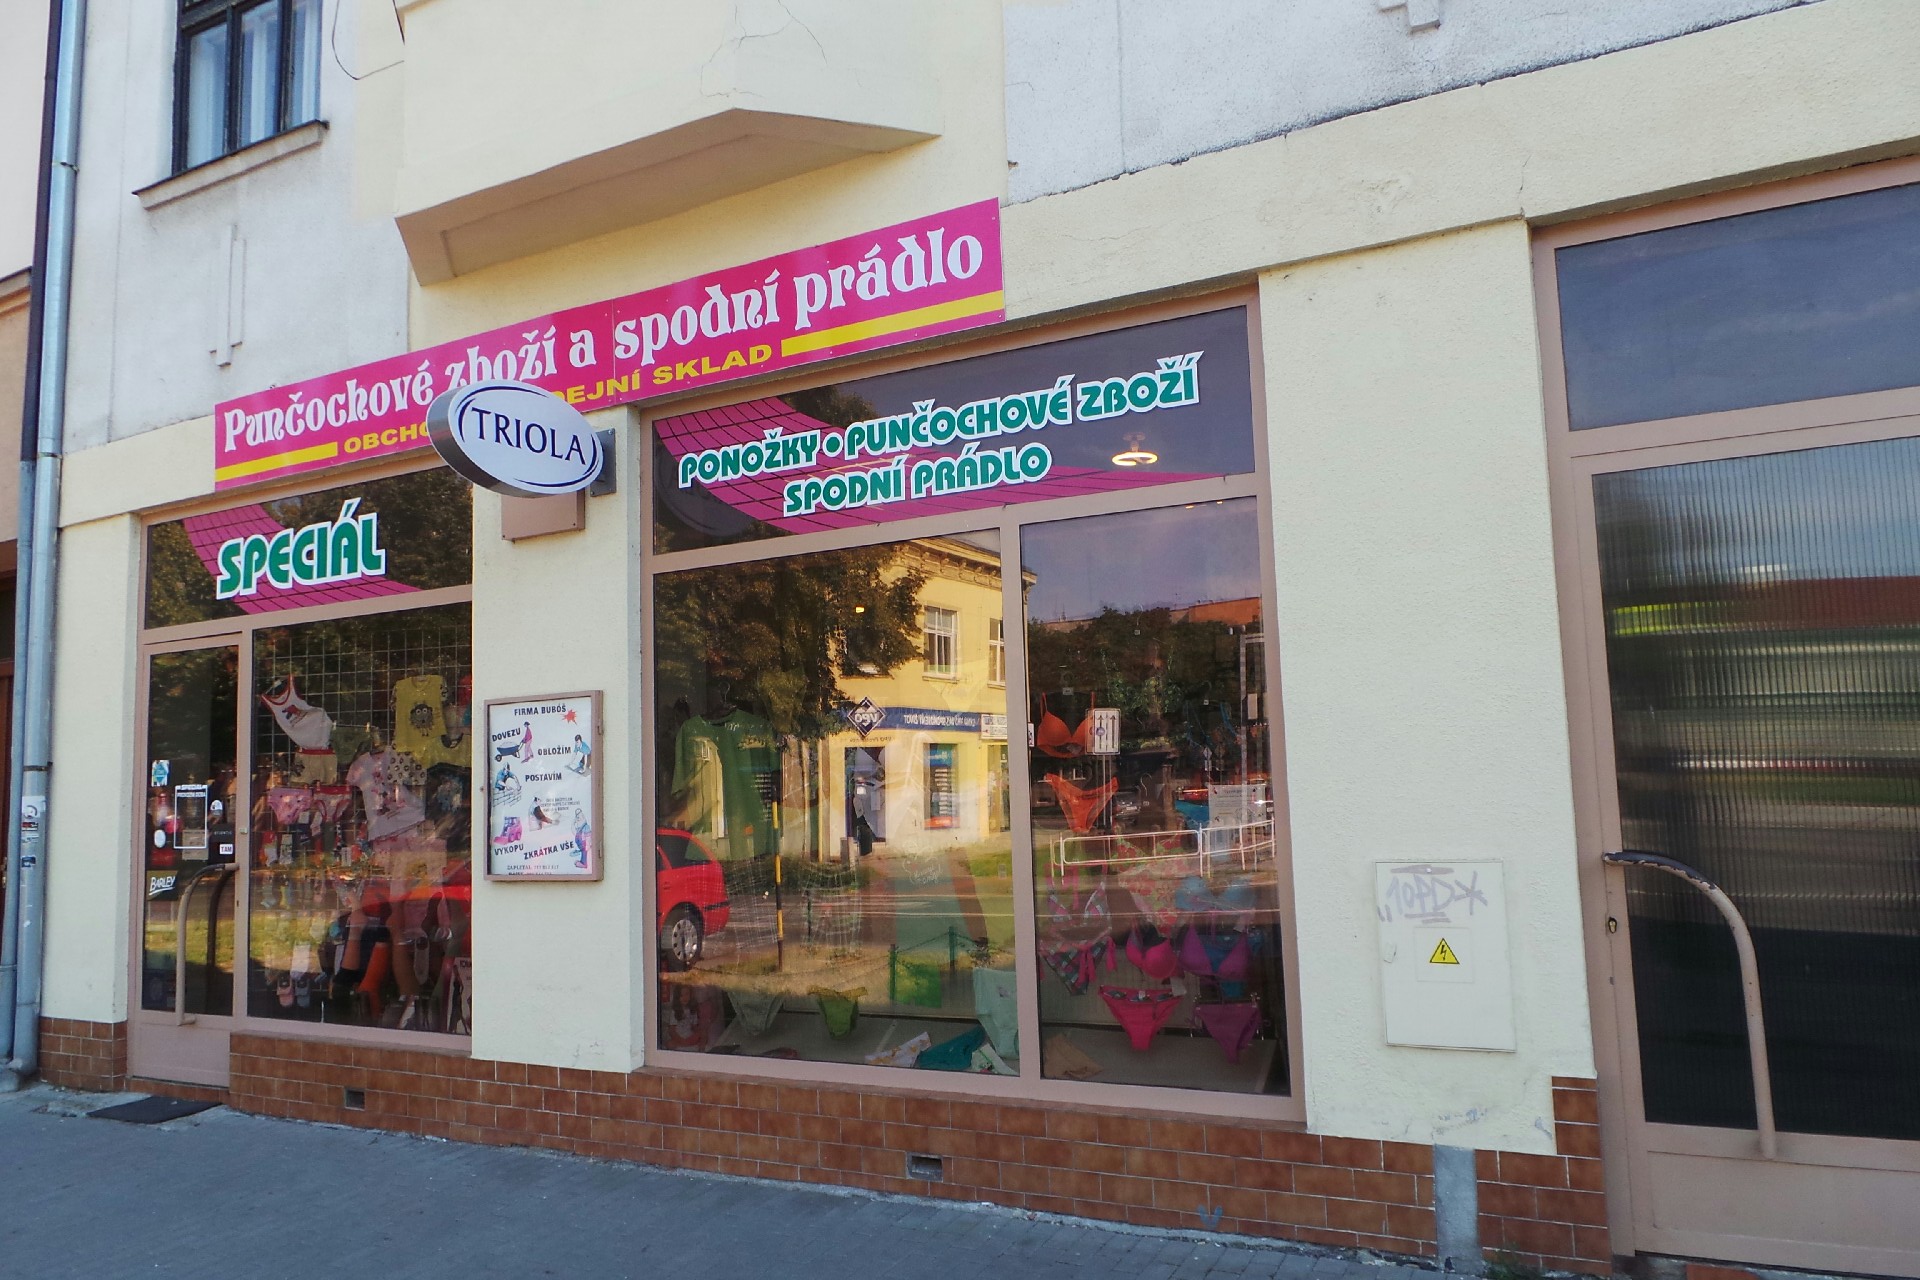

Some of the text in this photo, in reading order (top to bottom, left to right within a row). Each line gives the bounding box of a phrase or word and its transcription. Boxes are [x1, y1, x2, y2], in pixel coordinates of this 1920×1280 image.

[224, 226, 984, 452] Punčochové zboží a spodní prádlo
[652, 343, 773, 386] SKLAD
[679, 351, 1205, 488] PONOŽKY PUNČOCHOVÉ ZBOŽÍ
[471, 406, 586, 466] TRIOLA
[783, 442, 1053, 517] SPODNÍ PRÁDLO
[216, 497, 386, 600] SPECIÁL
[514, 706, 539, 716] FIRMA
[492, 727, 521, 742] DOVEZU
[538, 746, 571, 756] OBLOŽÍM
[525, 771, 562, 782] POSTAVÍM
[494, 843, 524, 856] VYKOPU
[524, 841, 575, 860] ZKRÁTKA VŠE
[149, 875, 176, 892] BARLEY
